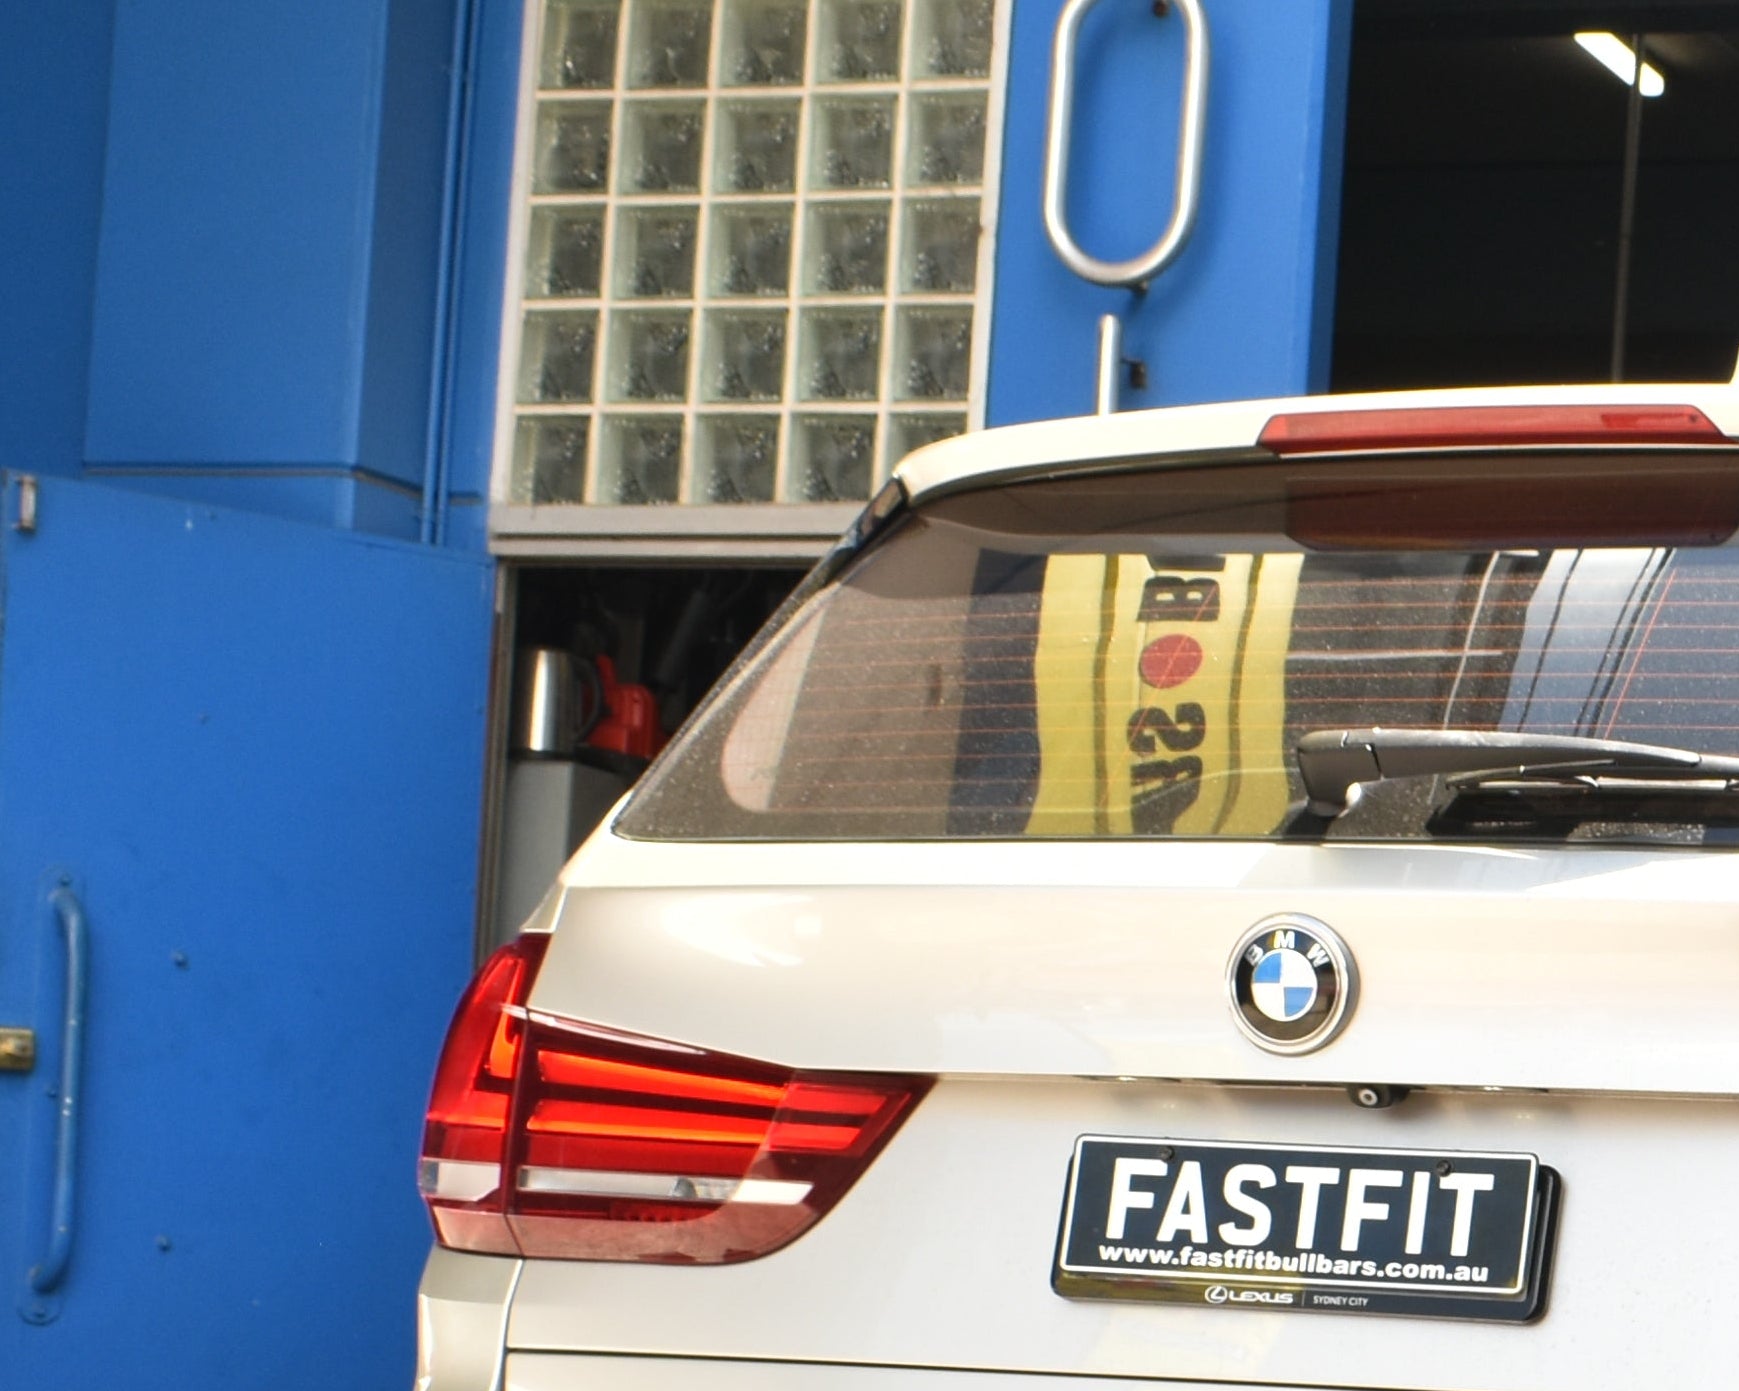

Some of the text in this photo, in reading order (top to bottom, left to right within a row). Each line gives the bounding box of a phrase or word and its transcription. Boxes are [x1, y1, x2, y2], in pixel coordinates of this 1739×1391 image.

[1244, 929, 1330, 968] BMW
[1105, 1156, 1496, 1258] FASTFIT
[1099, 1244, 1489, 1283] www.fastfitbullbars.com.au
[1228, 1290, 1369, 1307] LEXUS SYDNEY CITY
